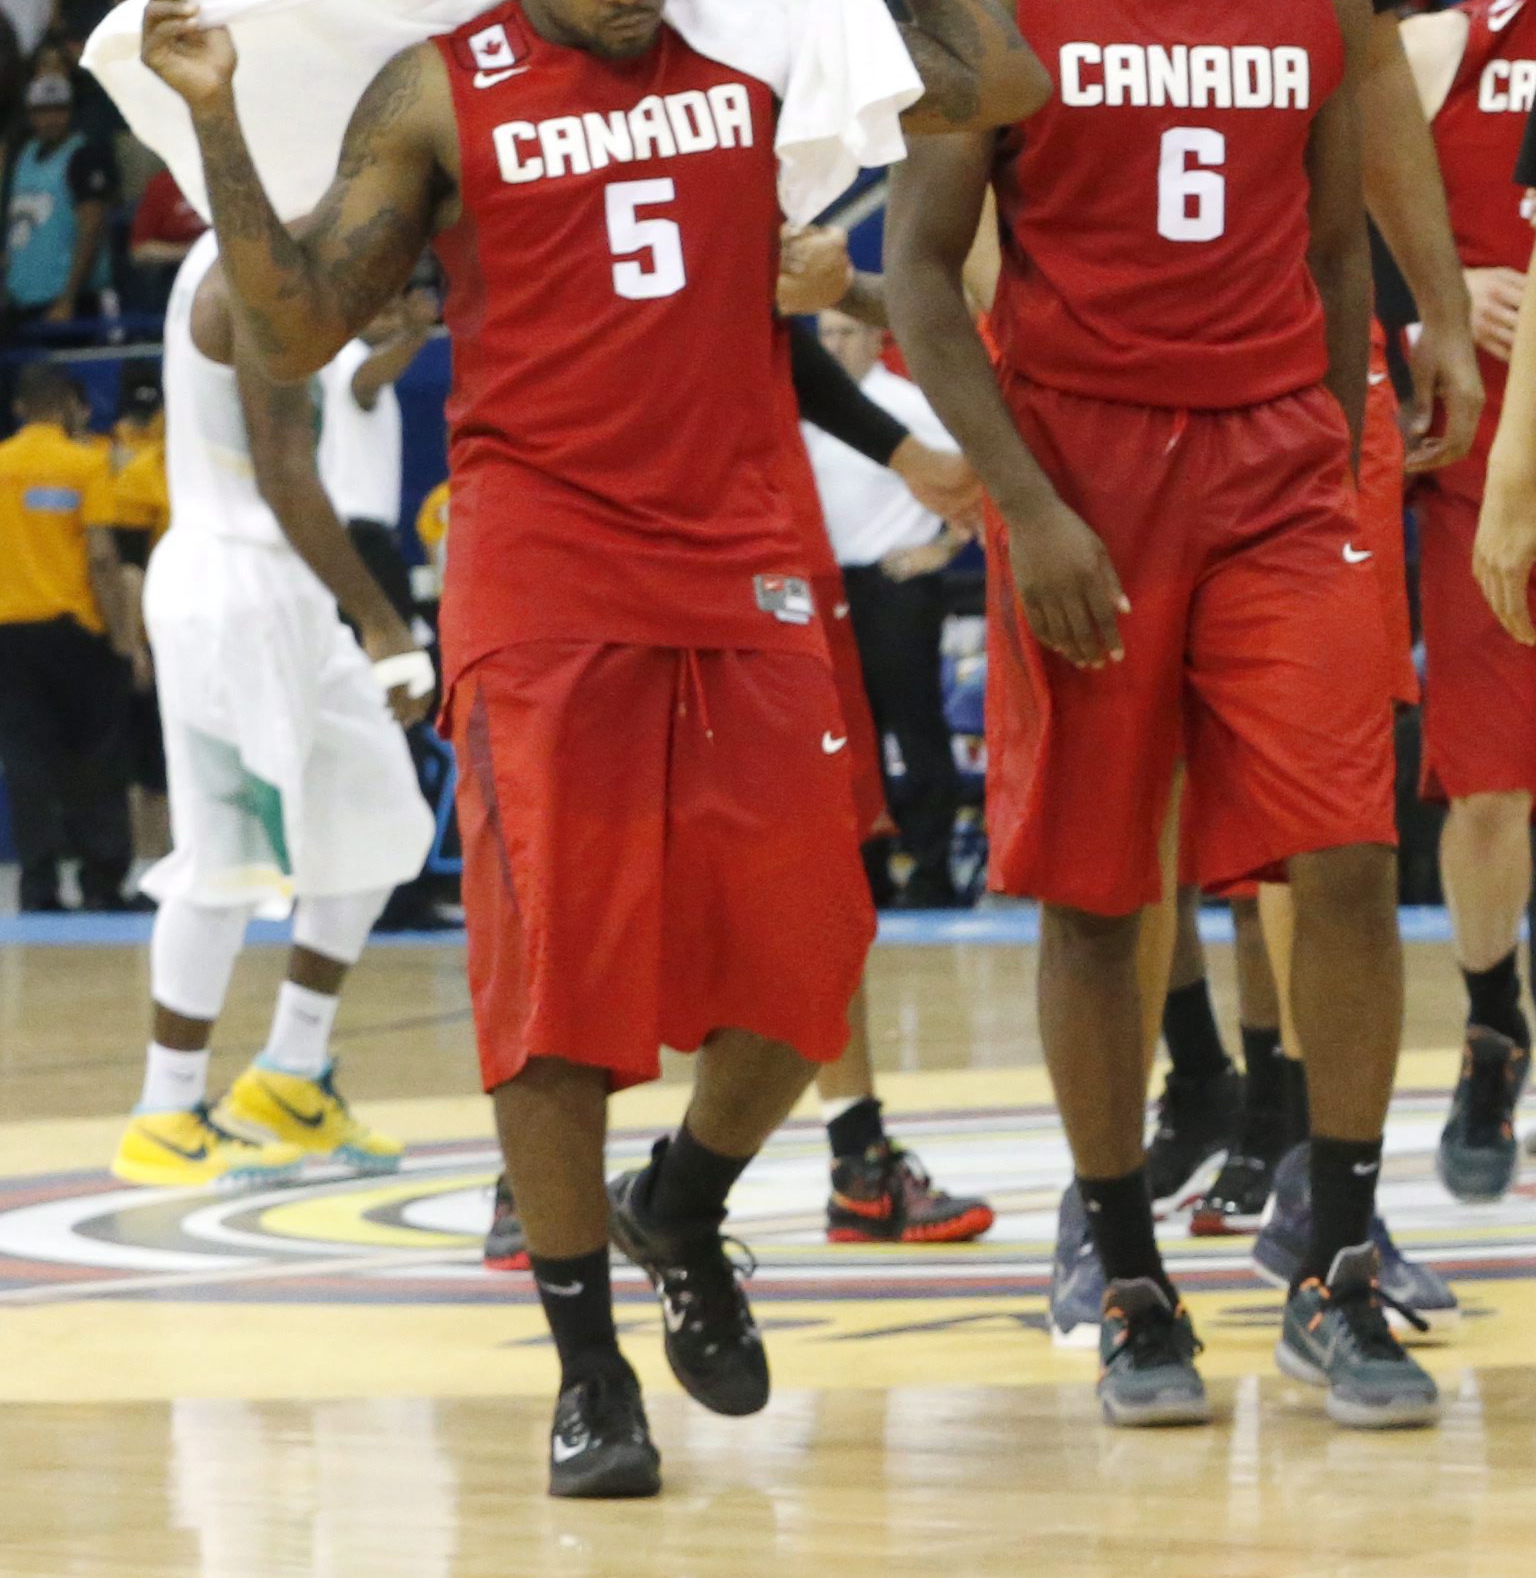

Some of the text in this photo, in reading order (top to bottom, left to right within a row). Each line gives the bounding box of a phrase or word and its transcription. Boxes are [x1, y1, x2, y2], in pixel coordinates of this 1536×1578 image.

[1059, 41, 1309, 110] CANADA
[492, 82, 754, 184] CANADA
[1157, 126, 1226, 242] 6
[604, 177, 687, 300] 5
